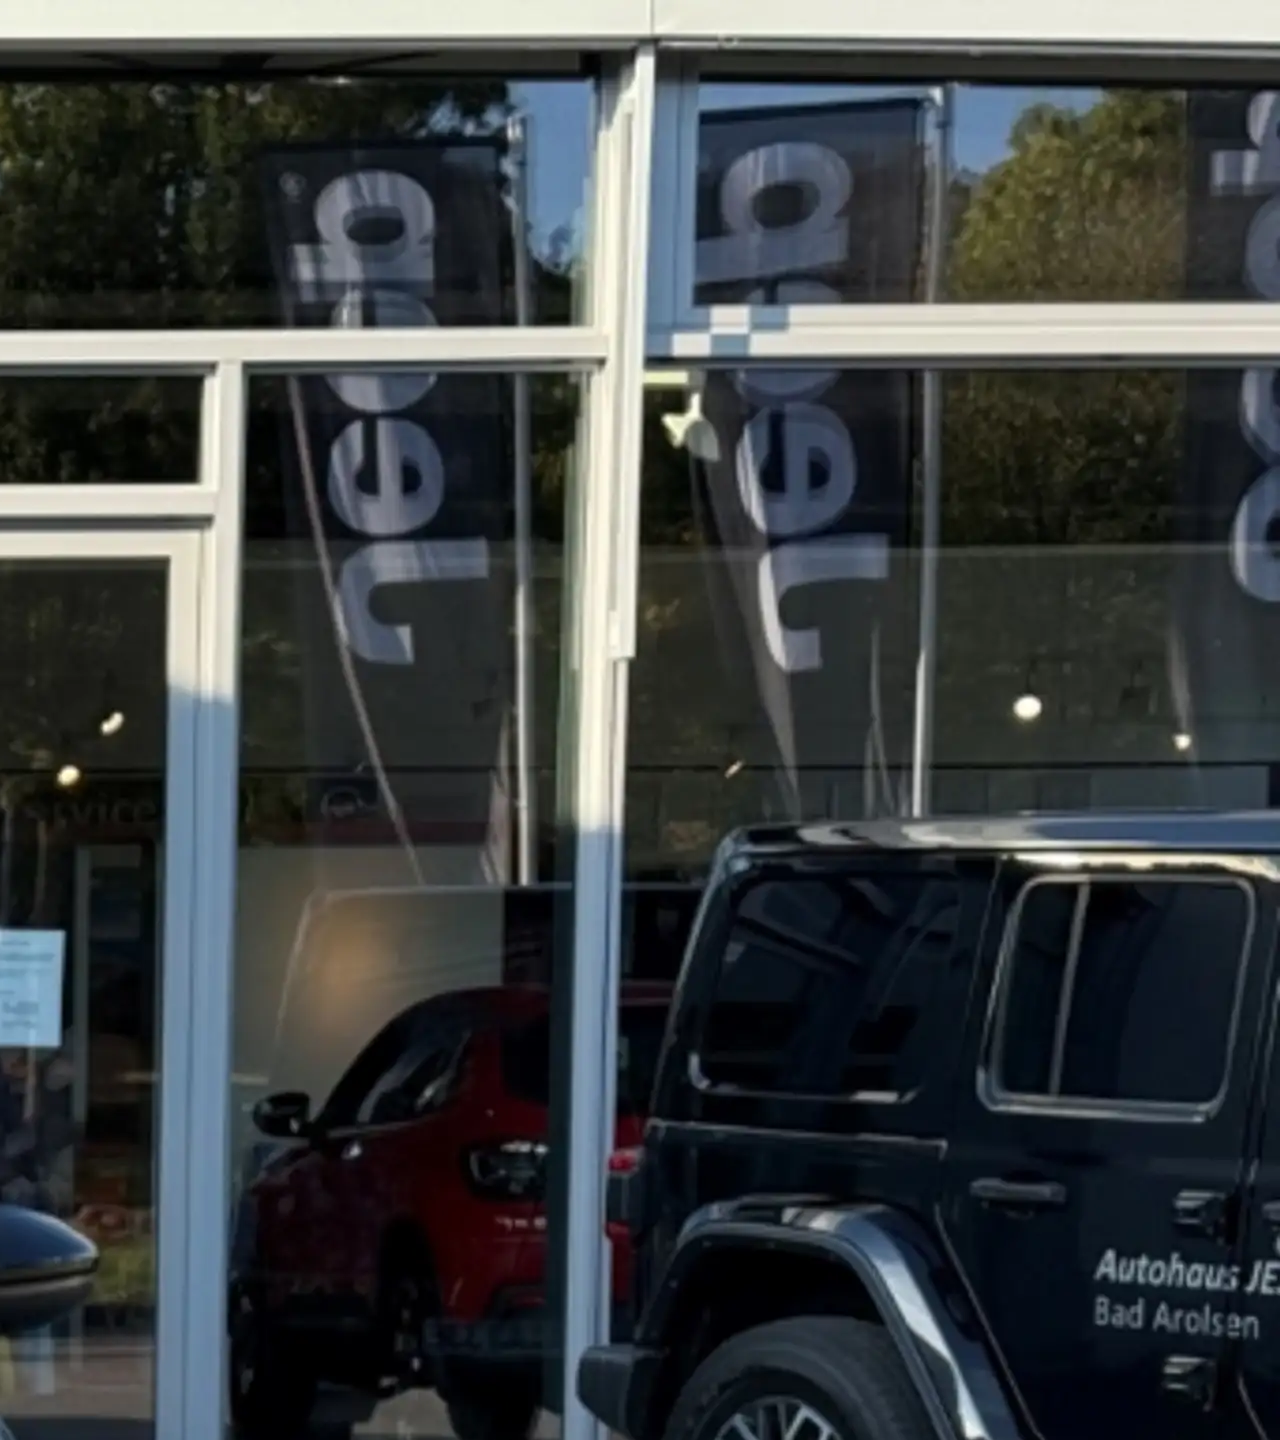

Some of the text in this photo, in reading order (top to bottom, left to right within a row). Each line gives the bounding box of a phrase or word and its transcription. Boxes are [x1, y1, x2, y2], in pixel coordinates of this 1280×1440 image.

[1094, 1249, 1280, 1296] Autohaus JE
[1095, 1294, 1259, 1339] Bad Arolsen
